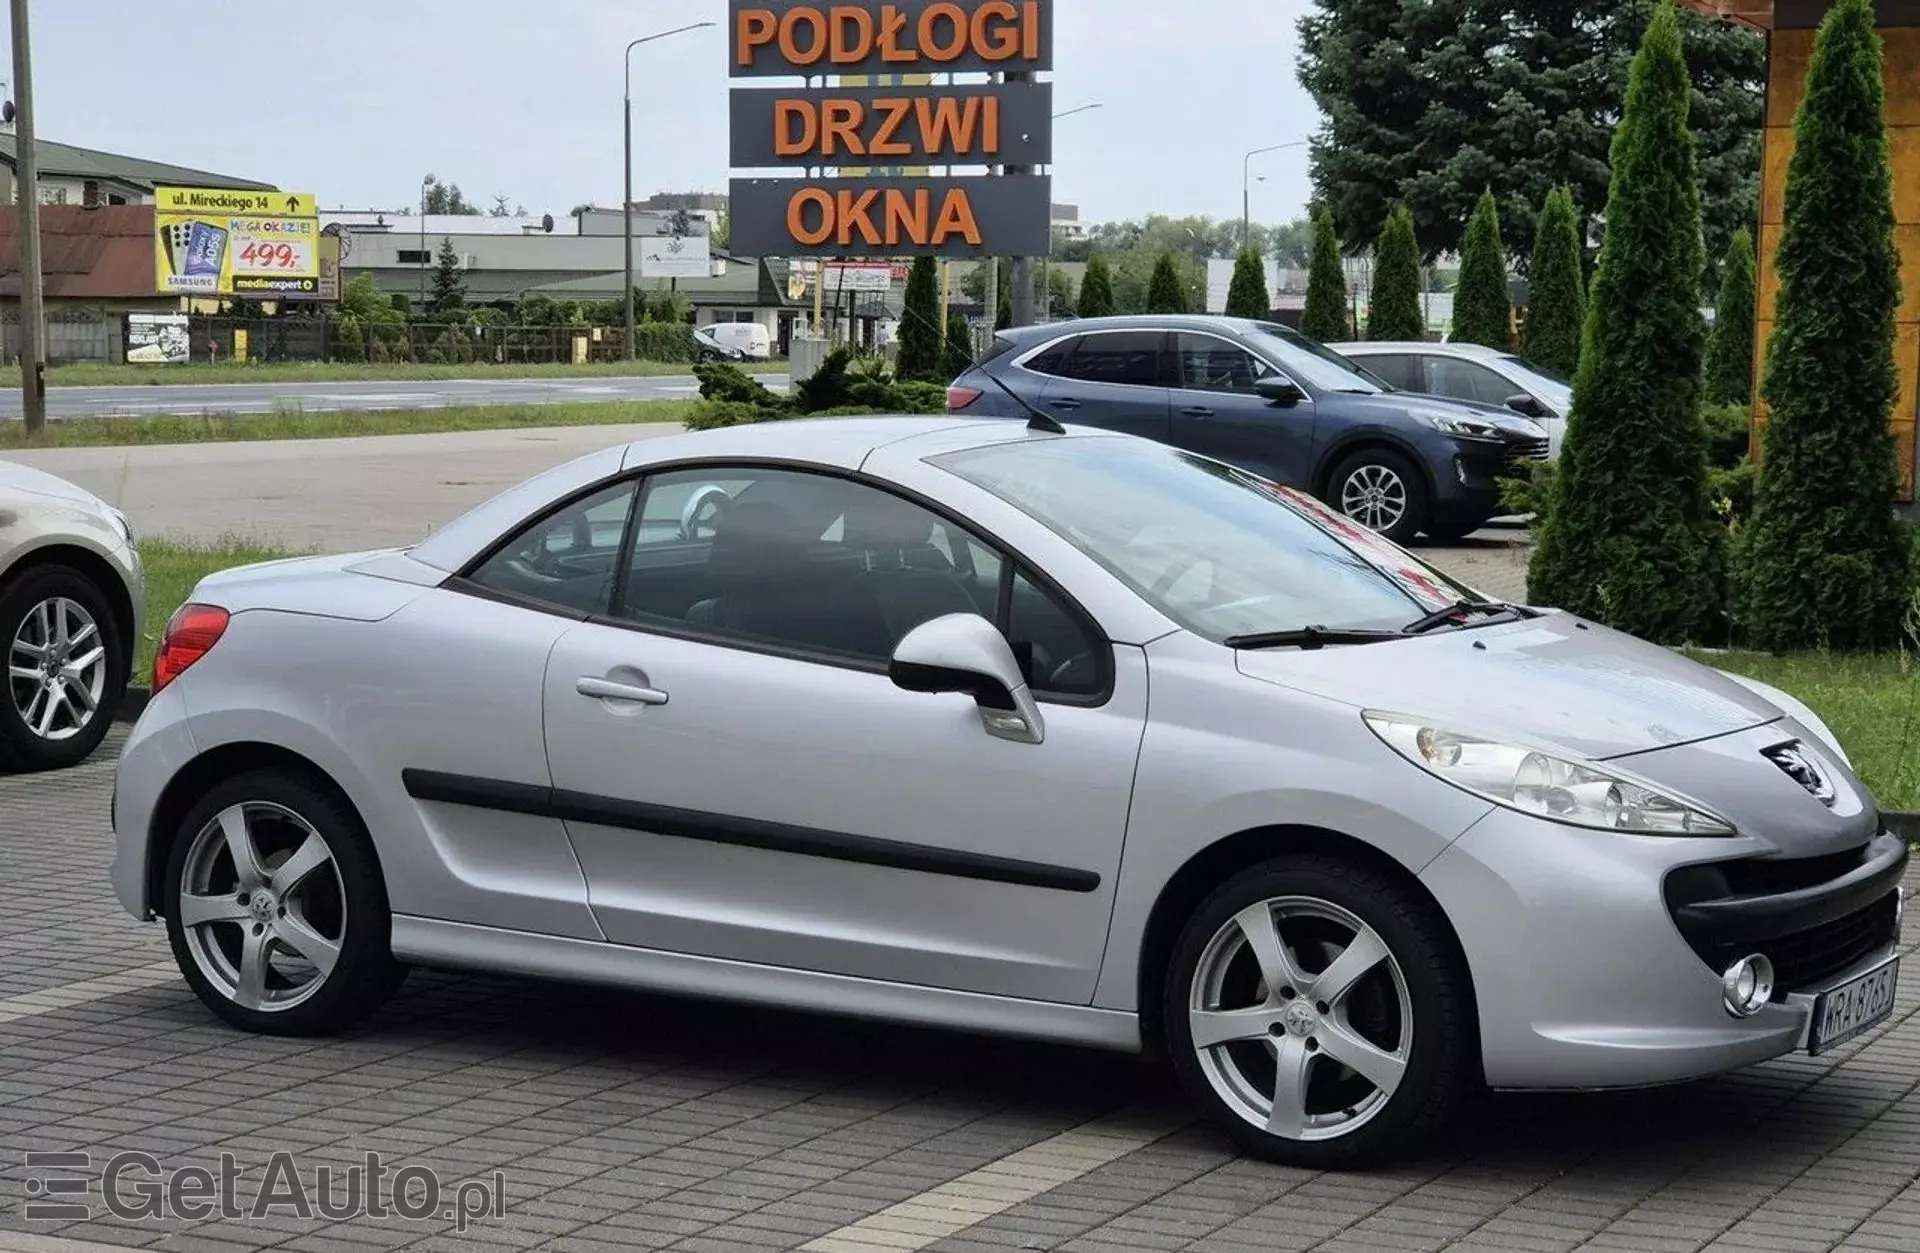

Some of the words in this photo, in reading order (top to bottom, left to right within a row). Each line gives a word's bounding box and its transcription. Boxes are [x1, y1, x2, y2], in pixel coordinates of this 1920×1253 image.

[737, 1, 1039, 65] PODŁOGI
[774, 95, 998, 155] DRZWI
[172, 192, 188, 205] ul.
[190, 193, 253, 211] Mireckiego
[256, 196, 268, 208] 14
[786, 187, 983, 246] OKNA
[168, 277, 213, 286] SAMSUNG
[237, 279, 302, 291] mediaexpert
[1823, 990, 1853, 1038] WRA
